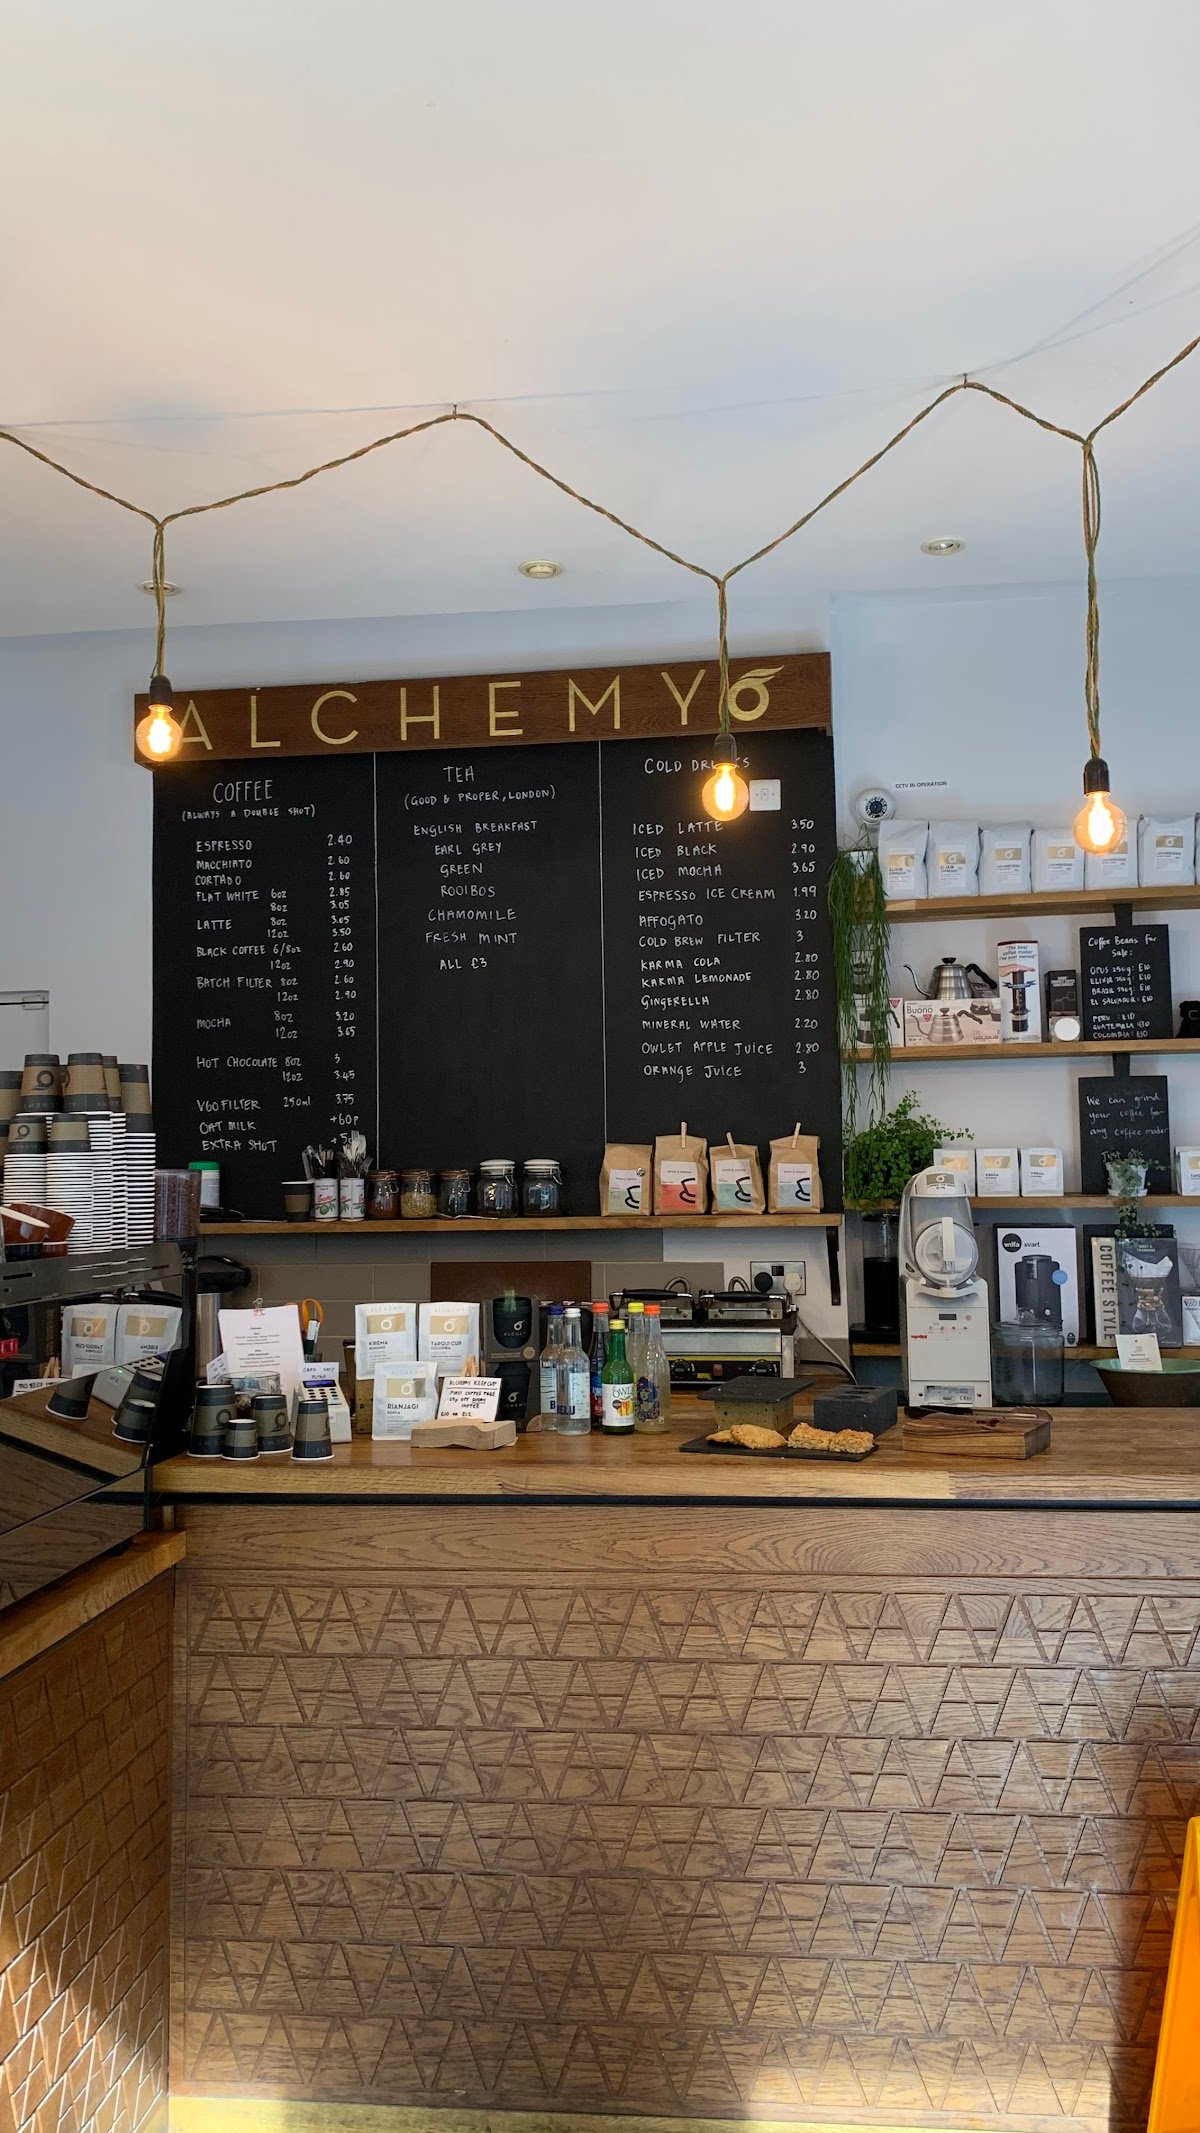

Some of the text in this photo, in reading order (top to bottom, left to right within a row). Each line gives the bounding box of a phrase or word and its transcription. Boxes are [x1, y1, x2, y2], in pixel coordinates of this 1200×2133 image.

[176, 669, 706, 751] ALCHEMY
[645, 758, 682, 773] COLD
[443, 766, 474, 782] TEA
[213, 780, 272, 803] COFFEE
[405, 794, 437, 810] (GOOD
[182, 811, 220, 821] (ALWAYS
[244, 808, 279, 817] DOUBLE
[288, 804, 315, 817] SHOT)
[414, 821, 537, 837] ENGLISH BREAKFAST
[634, 819, 814, 835] ICED LATTE 3.50
[196, 834, 352, 852] ESPRESSO 2.40
[435, 842, 501, 855] EARL GREY
[636, 843, 815, 859] ICED BLACK 2.90
[196, 856, 350, 870] MACCHIATO 2.60
[440, 863, 482, 877] GREEN
[195, 871, 350, 886] CORTADO 2.60
[637, 861, 815, 881] ICED MOCHA 3.65
[197, 887, 350, 902] FLAT WHITE 6oz 2.85
[441, 885, 495, 897] ROOIBOS
[639, 886, 816, 901] ESPRESSO ICE CREAM 1.99
[270, 900, 349, 912] 8oz 3.05
[198, 915, 350, 930] LATTE 8oz 3.05
[428, 909, 516, 921] CHAMOMILE
[639, 914, 703, 930] AFFOGATO
[268, 929, 289, 938] 12oz
[426, 932, 517, 944] FRESH MINT
[639, 930, 803, 947] COLD BREW FILTER 3
[197, 947, 227, 957] BLACK
[232, 945, 265, 955] COFFEE
[334, 942, 353, 952] 2.60
[1088, 937, 1112, 952] Coffee
[1115, 936, 1138, 945] Beans
[335, 959, 354, 969] 2.90
[440, 958, 487, 970] ALL £3
[641, 952, 818, 971] KARMA COLA 2.80
[1090, 967, 1109, 975] OPUS
[196, 977, 230, 989] BATCH
[237, 977, 272, 988] FILTER
[335, 975, 354, 984] 2.60
[642, 970, 819, 988] KARMA LEMONADE 2.80
[335, 991, 356, 1000] 2.90
[641, 989, 819, 1010] GINGERELLA 2.80
[906, 1006, 934, 1015] Buono
[197, 1018, 231, 1029] MOCHA
[335, 1011, 354, 1021] 3.20
[643, 1018, 818, 1030] MINERAL WATER 2.20
[642, 1042, 682, 1053] OWLET
[694, 1041, 726, 1052] APPLE
[796, 1042, 819, 1054] 2.80
[197, 1056, 219, 1068] HOT
[227, 1056, 277, 1067] CHOCOLATE
[335, 1054, 340, 1063] 3
[334, 1070, 355, 1081] 3.45
[644, 1065, 692, 1083] ORANGE
[799, 1061, 806, 1073] 3
[284, 1096, 311, 1107] 250ml
[1086, 1095, 1100, 1106] We
[1134, 1093, 1161, 1109] grind
[1089, 1112, 1111, 1124] your
[1120, 1109, 1144, 1122] coffee
[199, 1121, 222, 1134] OAT
[228, 1121, 256, 1131] MILK
[1089, 1126, 1169, 1140] any coffee maker
[202, 1139, 277, 1152] EXTRA SHOT
[1003, 1239, 1020, 1248] wilfa
[1099, 1244, 1117, 1341] COFFEE STYLE
